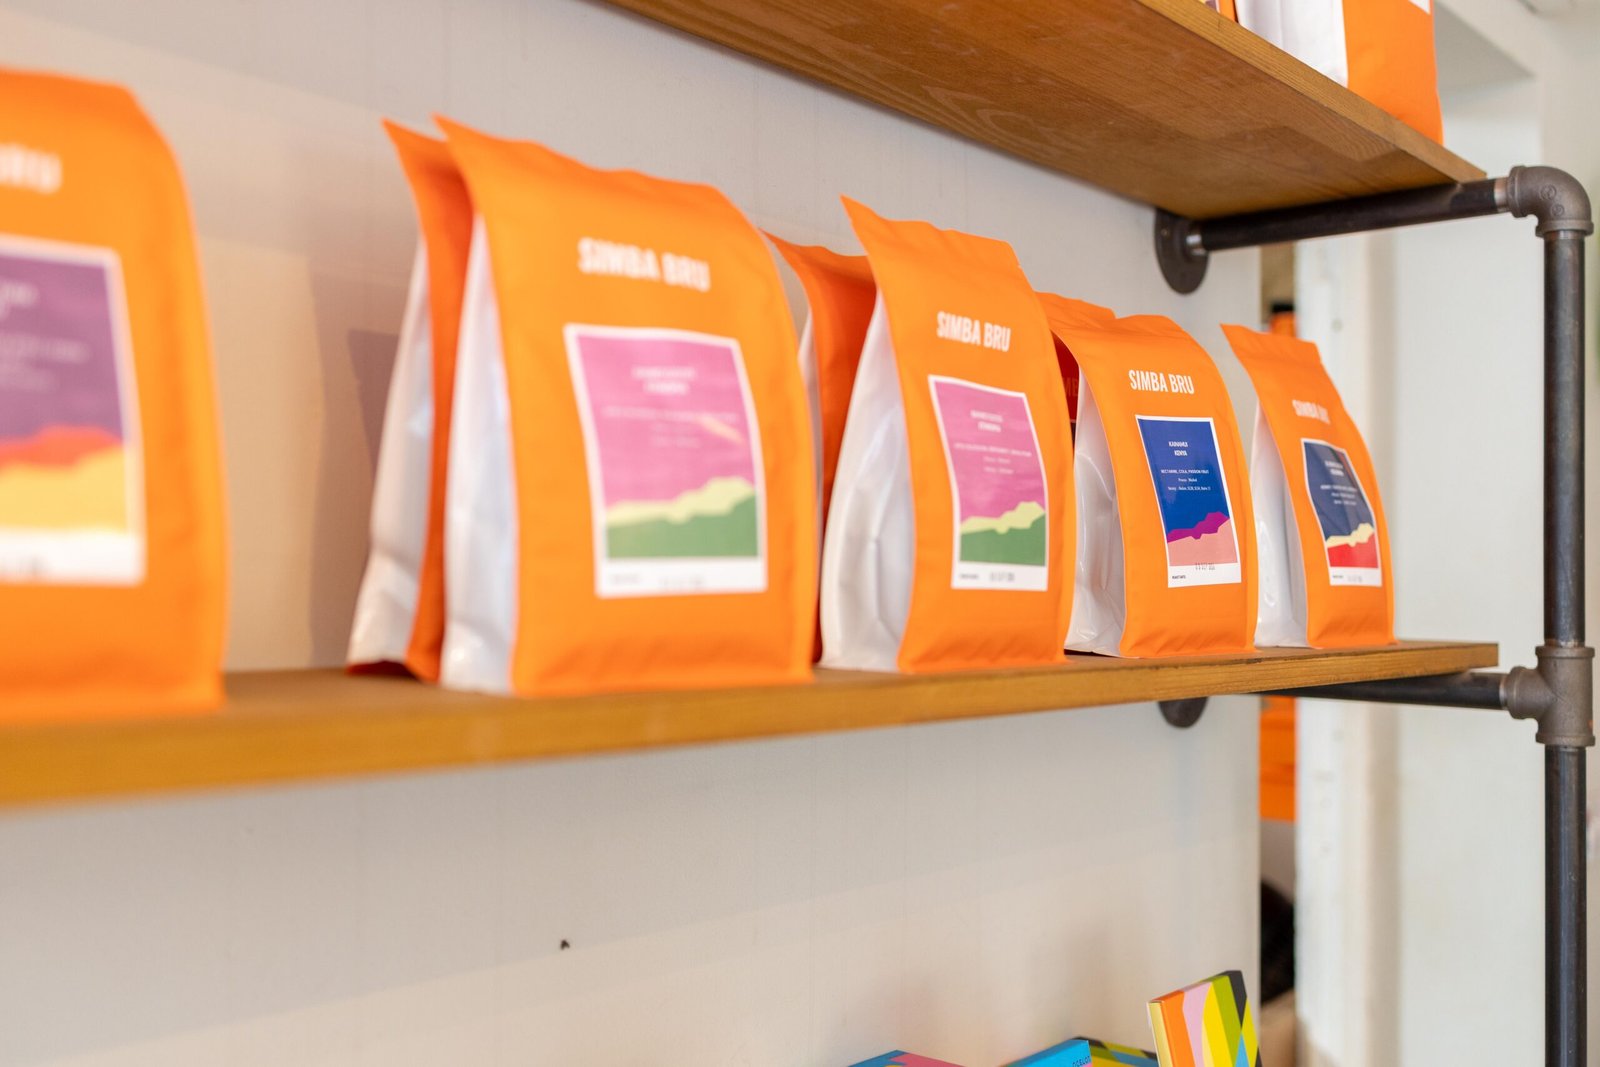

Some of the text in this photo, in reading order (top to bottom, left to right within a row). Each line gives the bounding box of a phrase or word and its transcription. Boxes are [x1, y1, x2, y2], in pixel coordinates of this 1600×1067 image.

[578, 237, 711, 293] SIMBA BRU
[937, 311, 1011, 352] SIMBA BRU
[1128, 369, 1195, 395] SIMBA BRU
